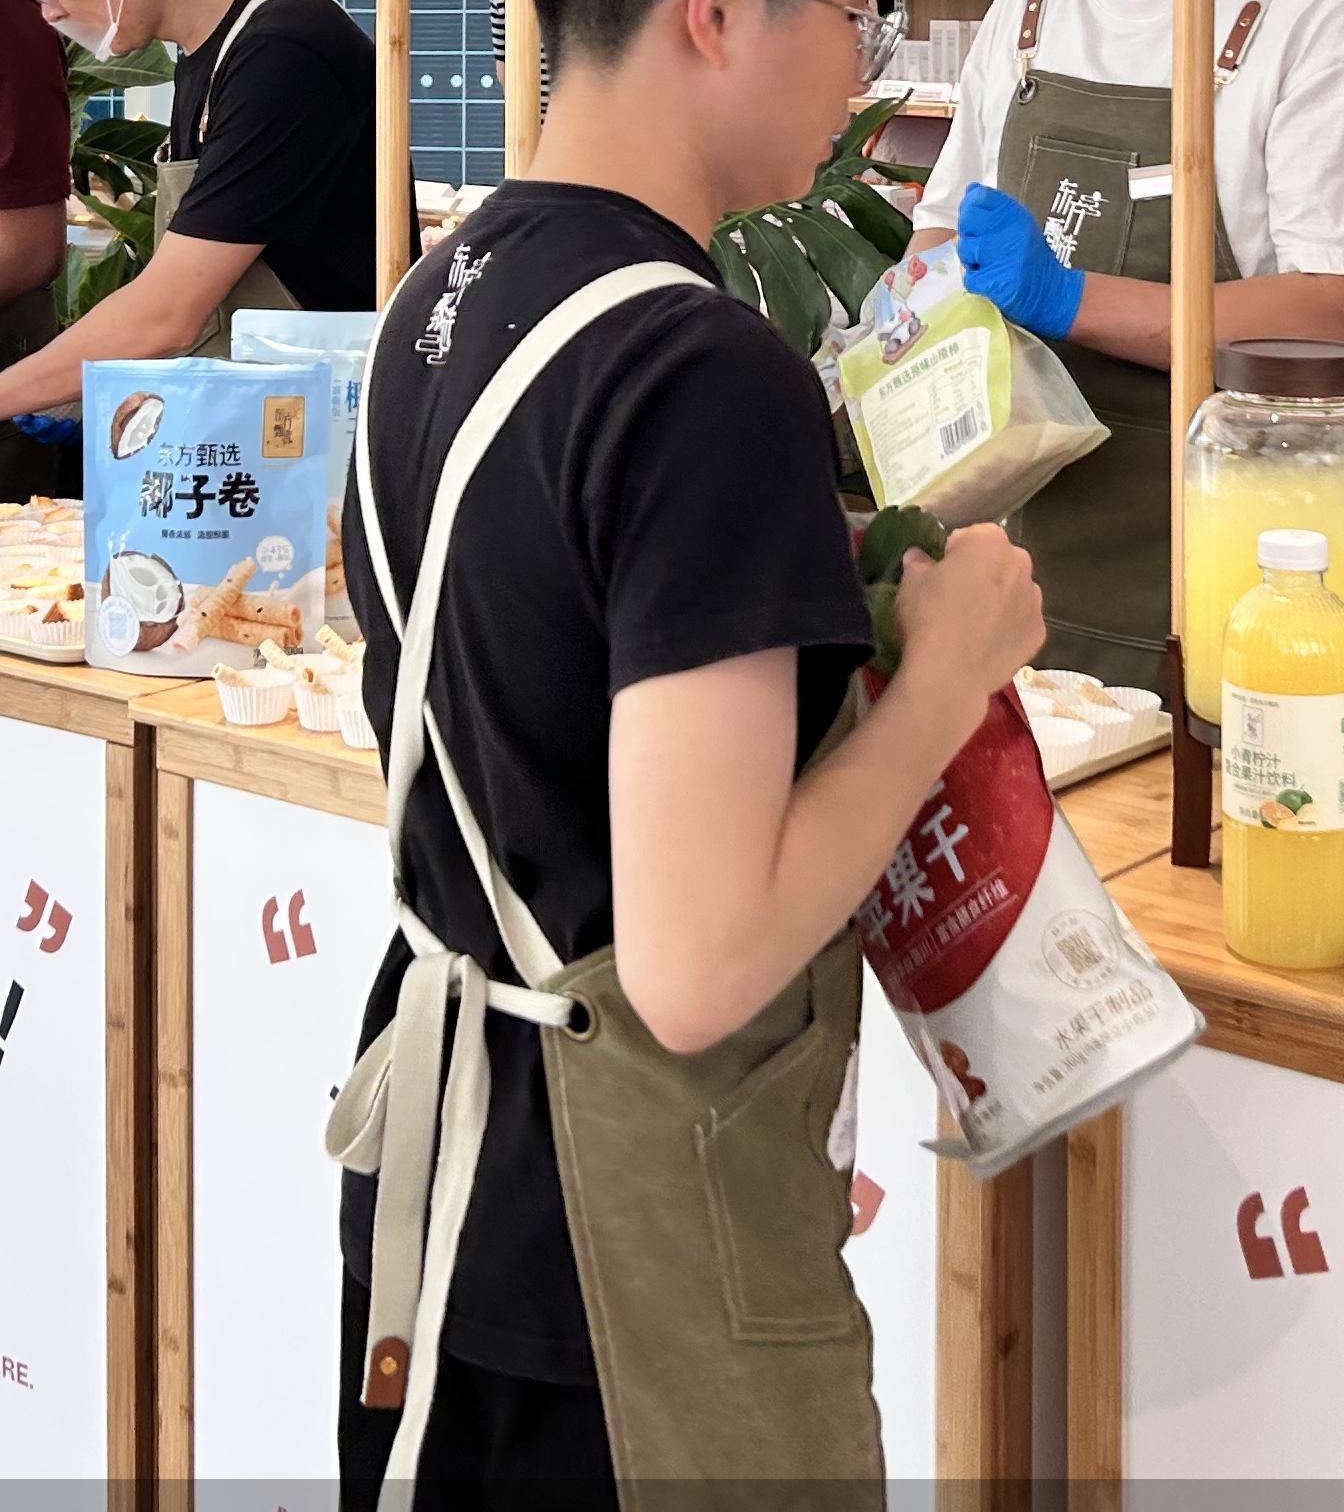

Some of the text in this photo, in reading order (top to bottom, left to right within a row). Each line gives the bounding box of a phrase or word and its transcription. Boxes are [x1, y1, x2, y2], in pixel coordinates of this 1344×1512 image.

[157, 442, 241, 467] 东方甄选
[139, 470, 261, 520] 椰子卷
